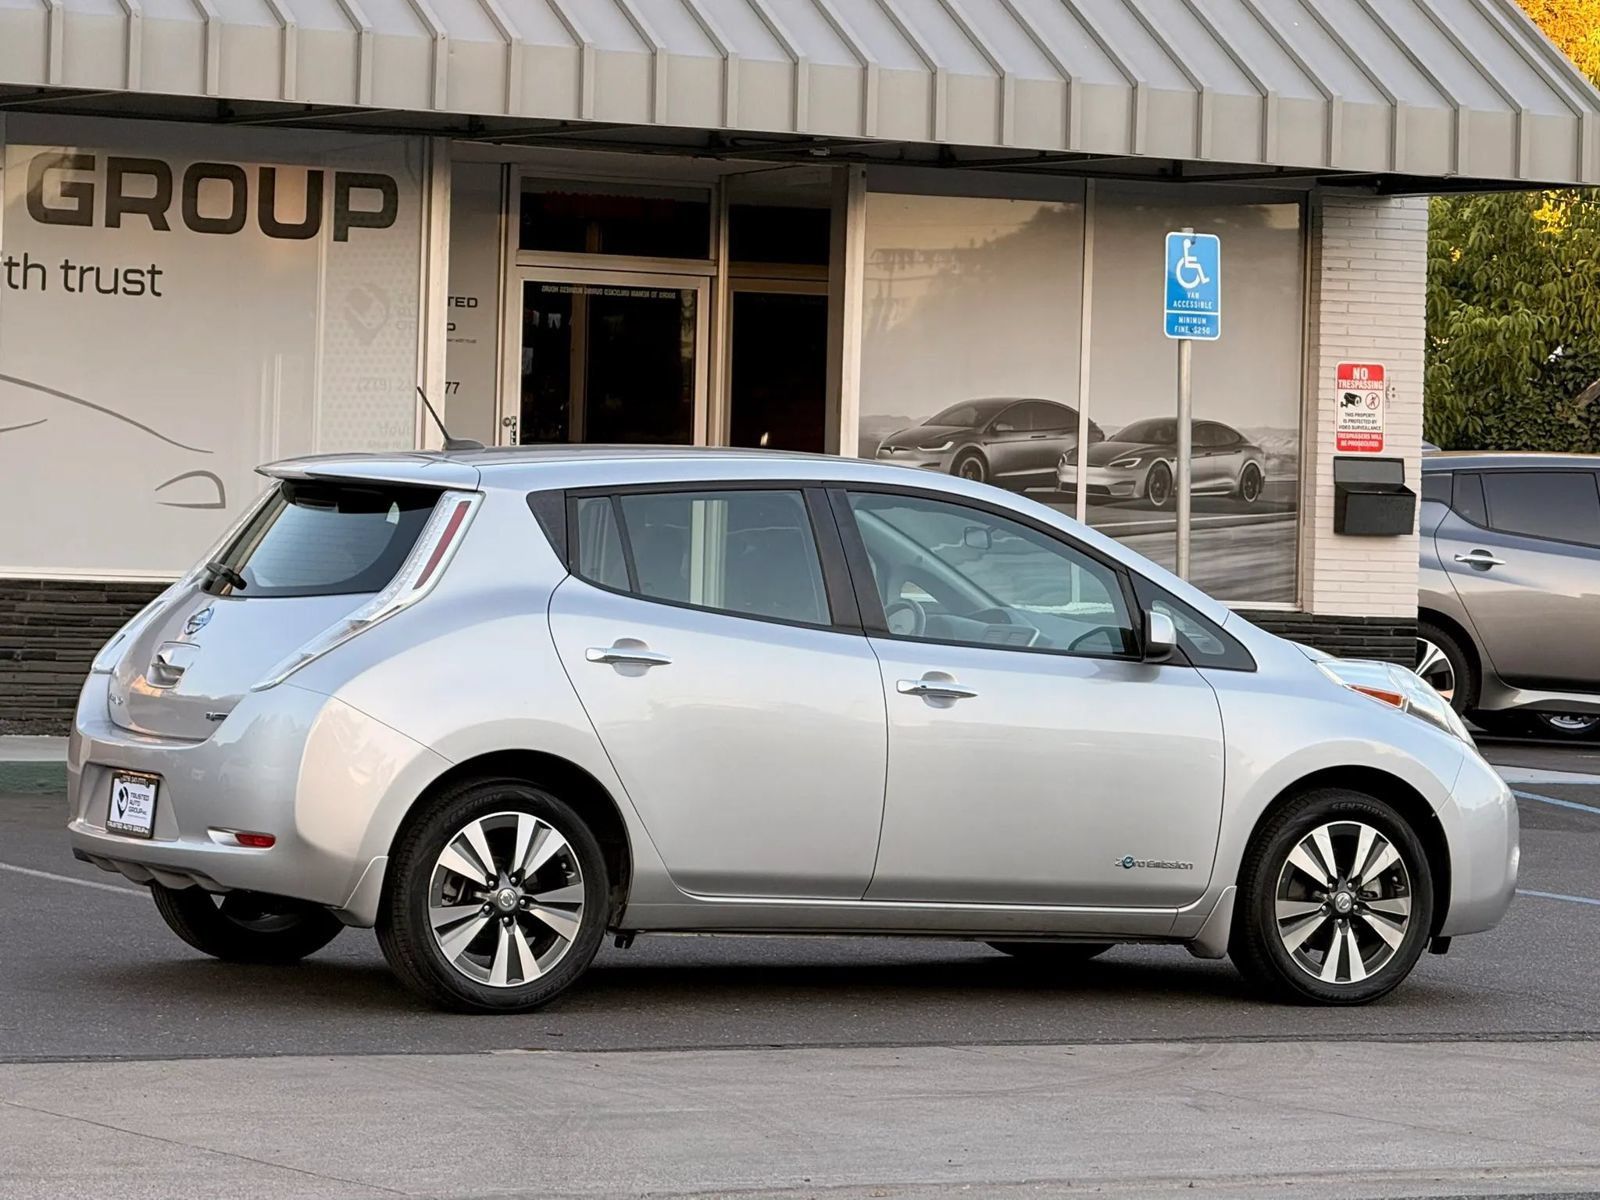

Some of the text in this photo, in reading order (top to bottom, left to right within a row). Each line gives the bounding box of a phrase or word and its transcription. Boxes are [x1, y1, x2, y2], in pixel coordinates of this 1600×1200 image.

[27, 152, 398, 242] GROUP
[60, 259, 163, 297] trust
[1186, 291, 1200, 299] VAN
[1173, 300, 1213, 310] ACCESSIBLE
[1178, 316, 1207, 324] MINIMUM
[1174, 325, 1190, 333] FINE
[1352, 367, 1368, 380] NO
[1338, 380, 1383, 389] TRESPASSING
[1146, 860, 1193, 870] Emission
